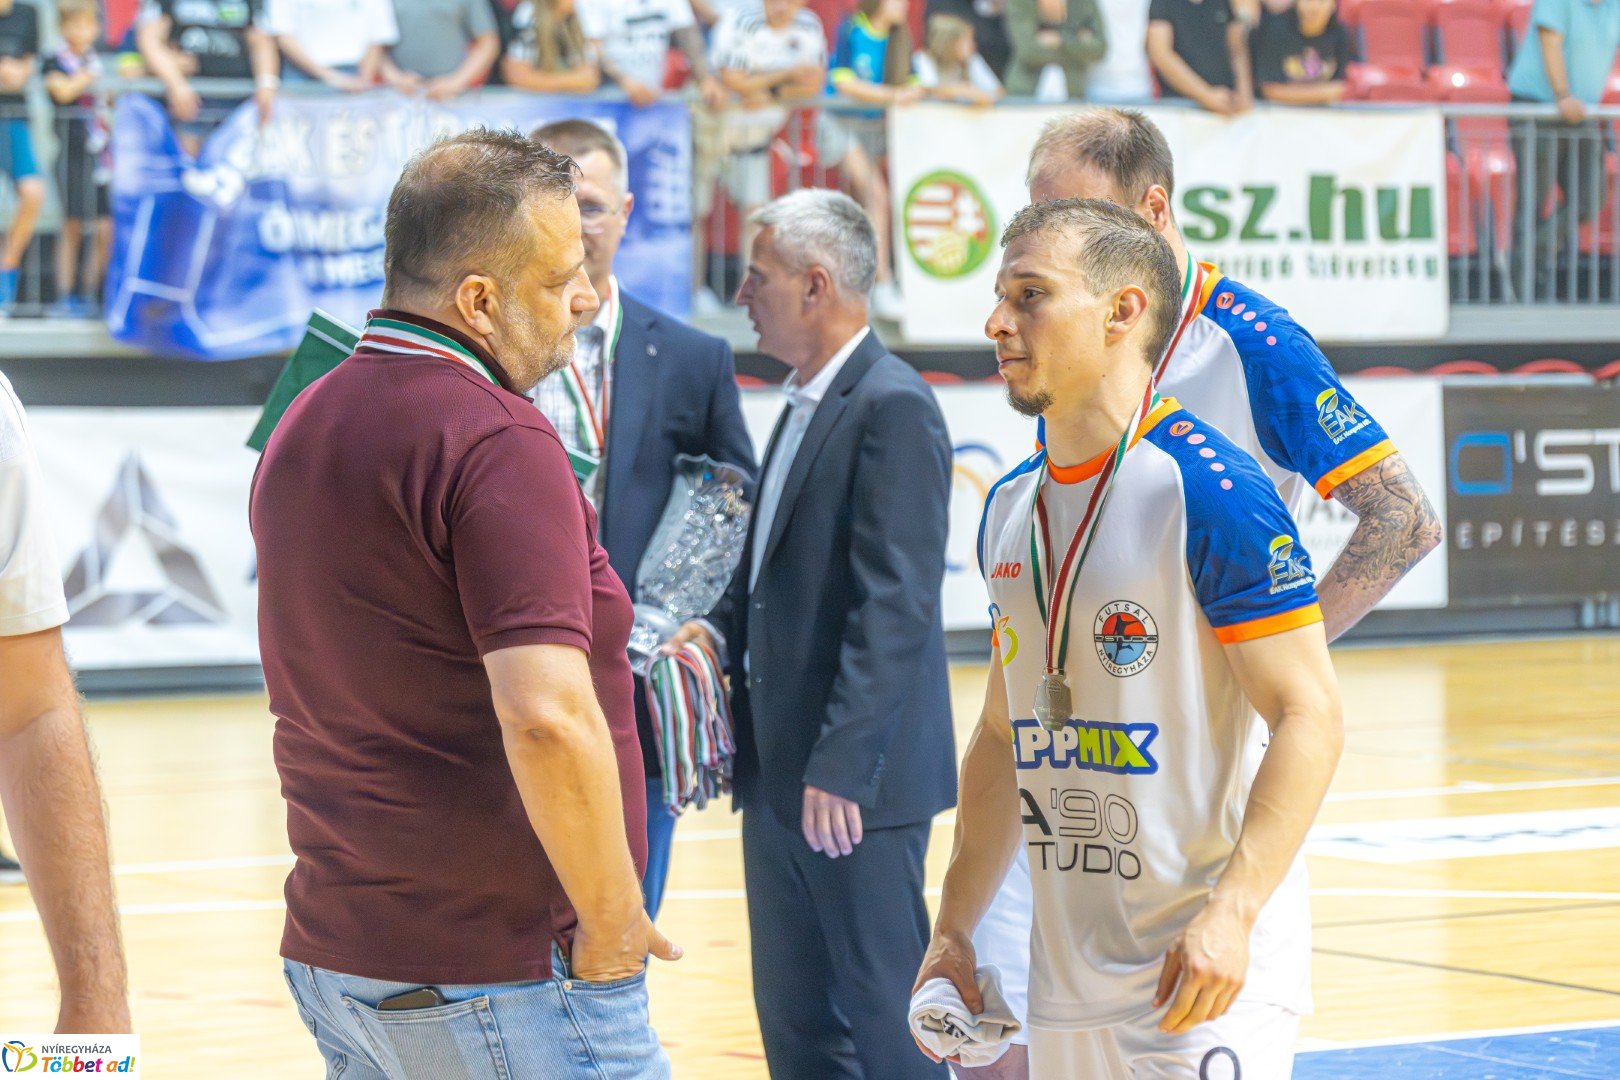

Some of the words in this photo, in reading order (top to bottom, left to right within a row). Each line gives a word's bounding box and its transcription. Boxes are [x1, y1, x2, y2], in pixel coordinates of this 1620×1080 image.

[1182, 174, 1434, 242] sz.hu
[991, 562, 1022, 579] JAKO
[1099, 603, 1148, 624] FUTSAL
[1099, 649, 1153, 674] NYÍREGYHÁZA
[1010, 723, 1155, 770] PPMIX
[1028, 841, 1141, 880] TUDIO
